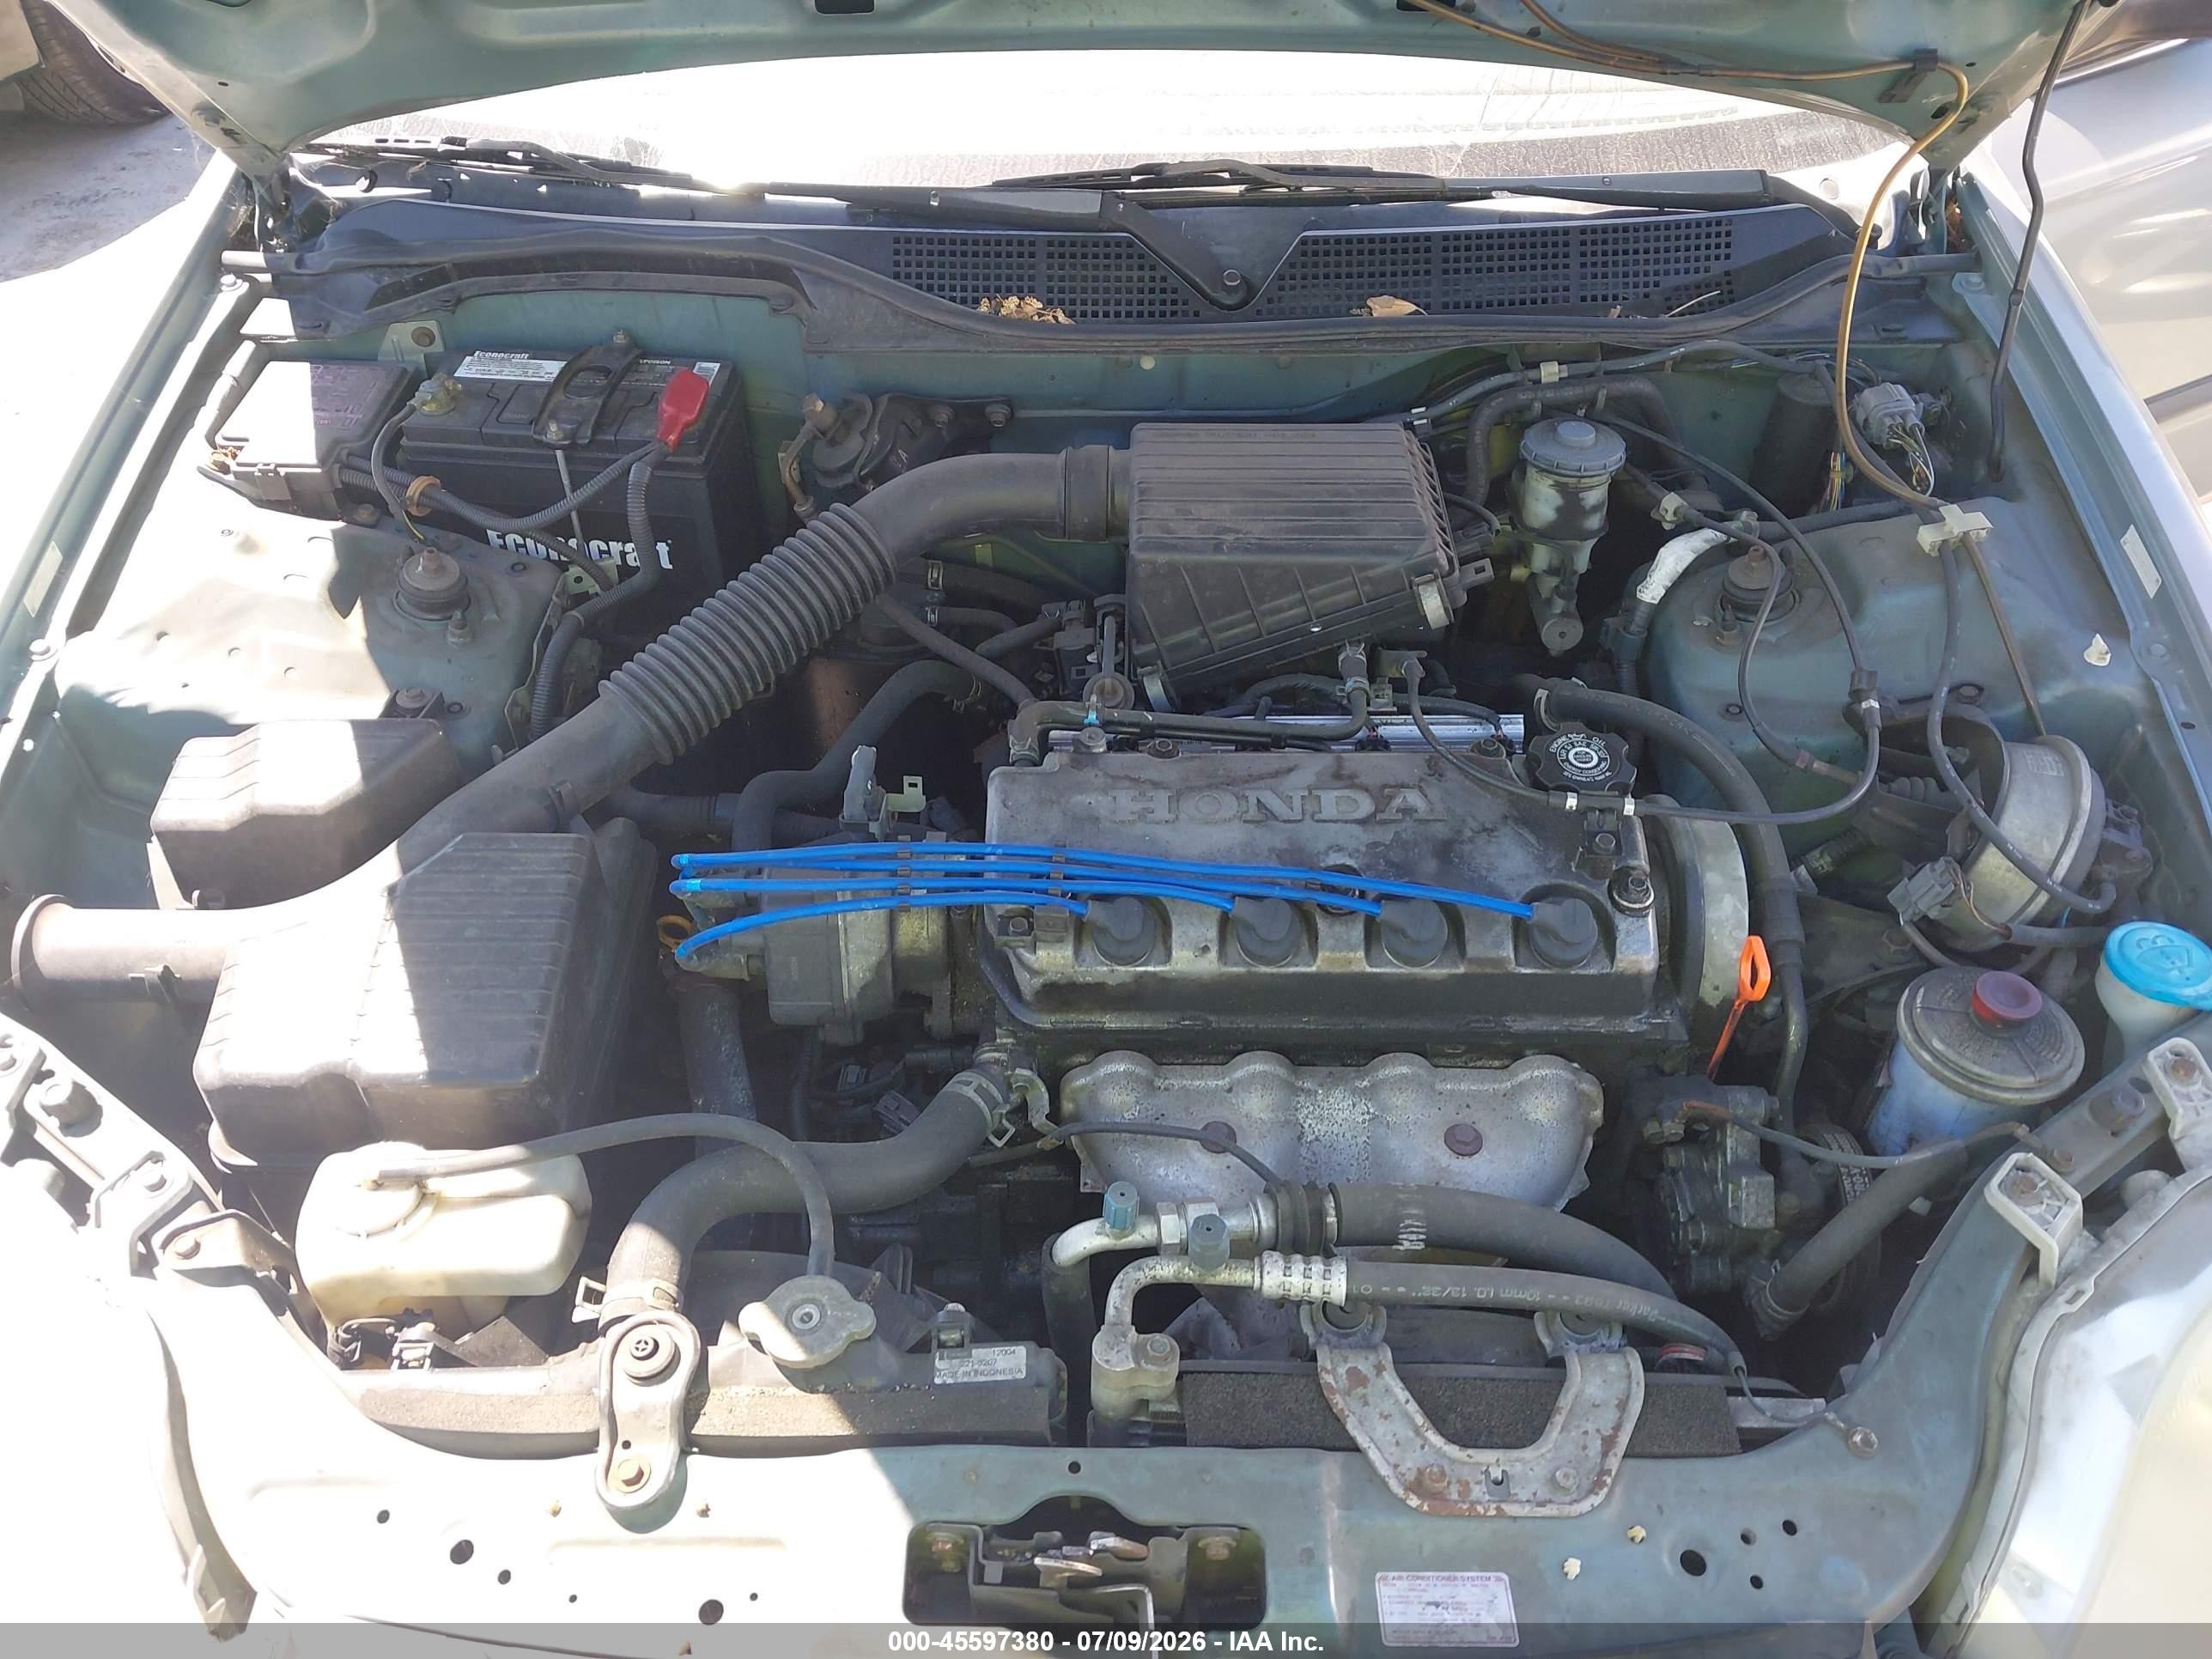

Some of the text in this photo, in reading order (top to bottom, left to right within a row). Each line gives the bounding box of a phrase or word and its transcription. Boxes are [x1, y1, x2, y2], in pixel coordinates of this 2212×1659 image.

[473, 350, 530, 359] Econocraft
[1549, 734, 1607, 753] ENGINE OIL
[1106, 787, 1448, 823] HONDA
[934, 1370, 960, 1379] MADE
[973, 1367, 1024, 1377] INDONESIA
